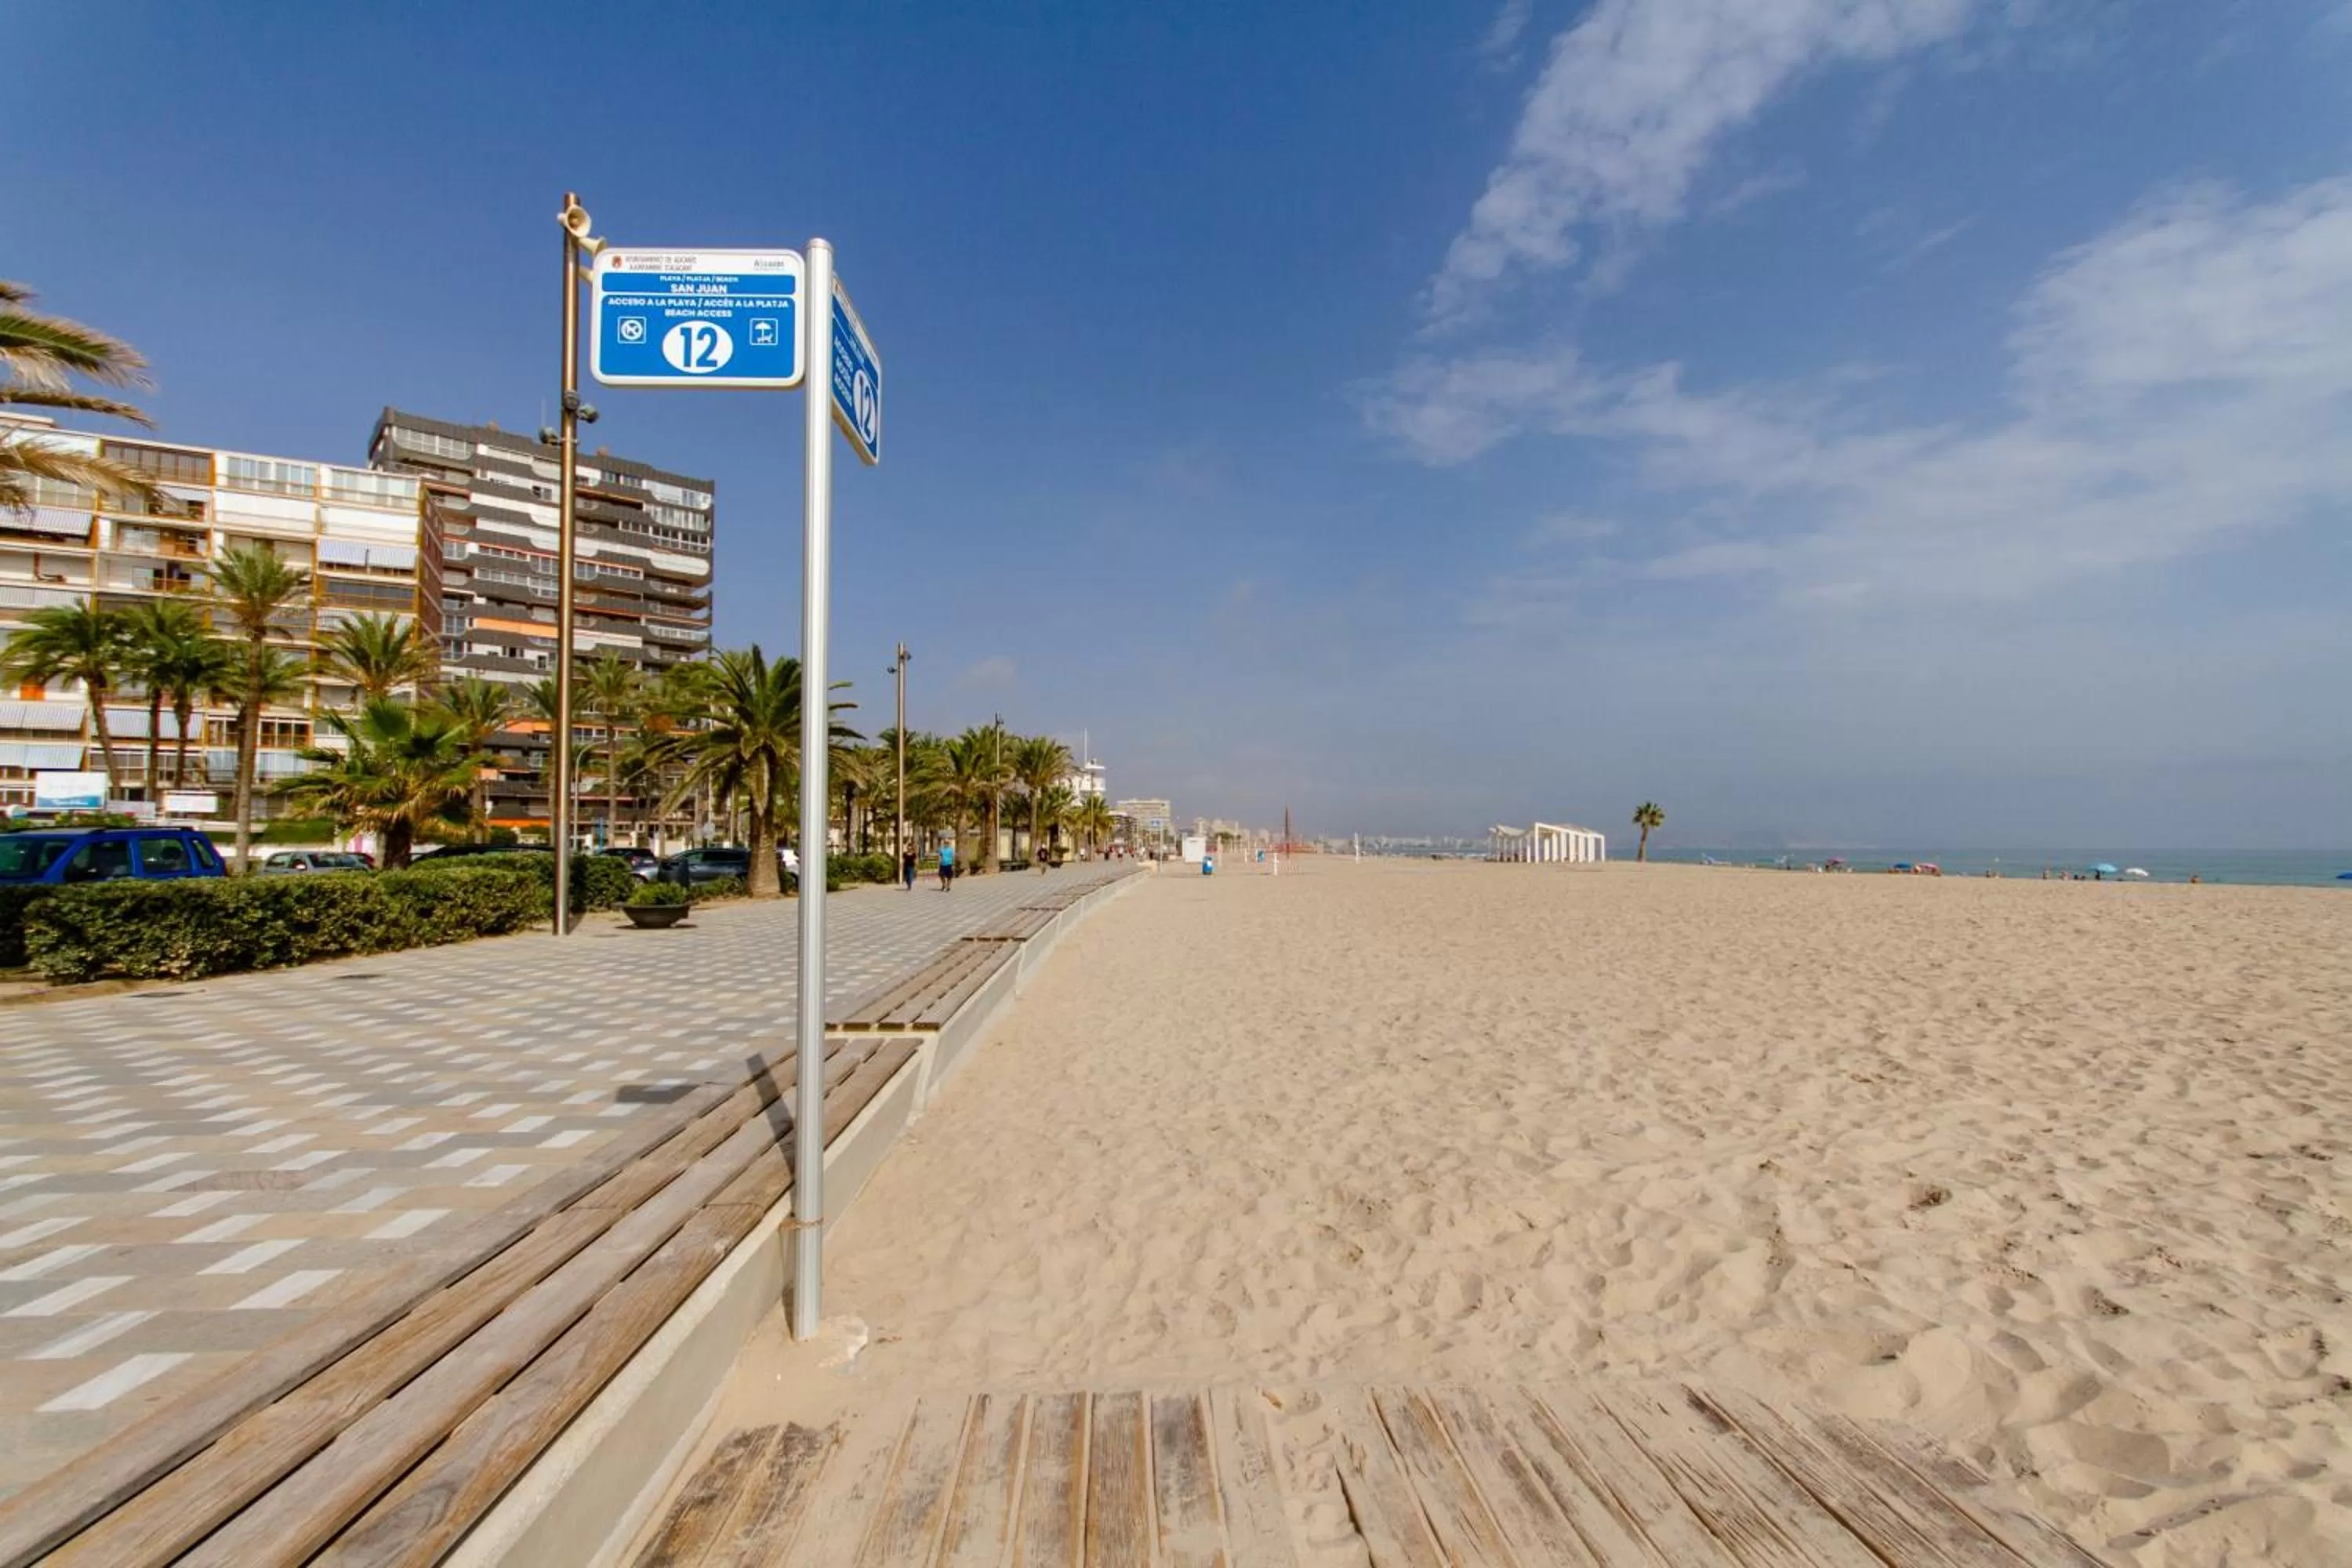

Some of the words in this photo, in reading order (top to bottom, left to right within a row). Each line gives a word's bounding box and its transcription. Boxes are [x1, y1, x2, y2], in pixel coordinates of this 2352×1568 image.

[671, 283, 694, 293] SAN
[697, 284, 728, 294] JUAN
[608, 298, 646, 307] ACCESO
[667, 299, 696, 307] PLAYA
[665, 309, 695, 318] BEACH
[680, 326, 718, 368] 12
[858, 372, 873, 439] 12
